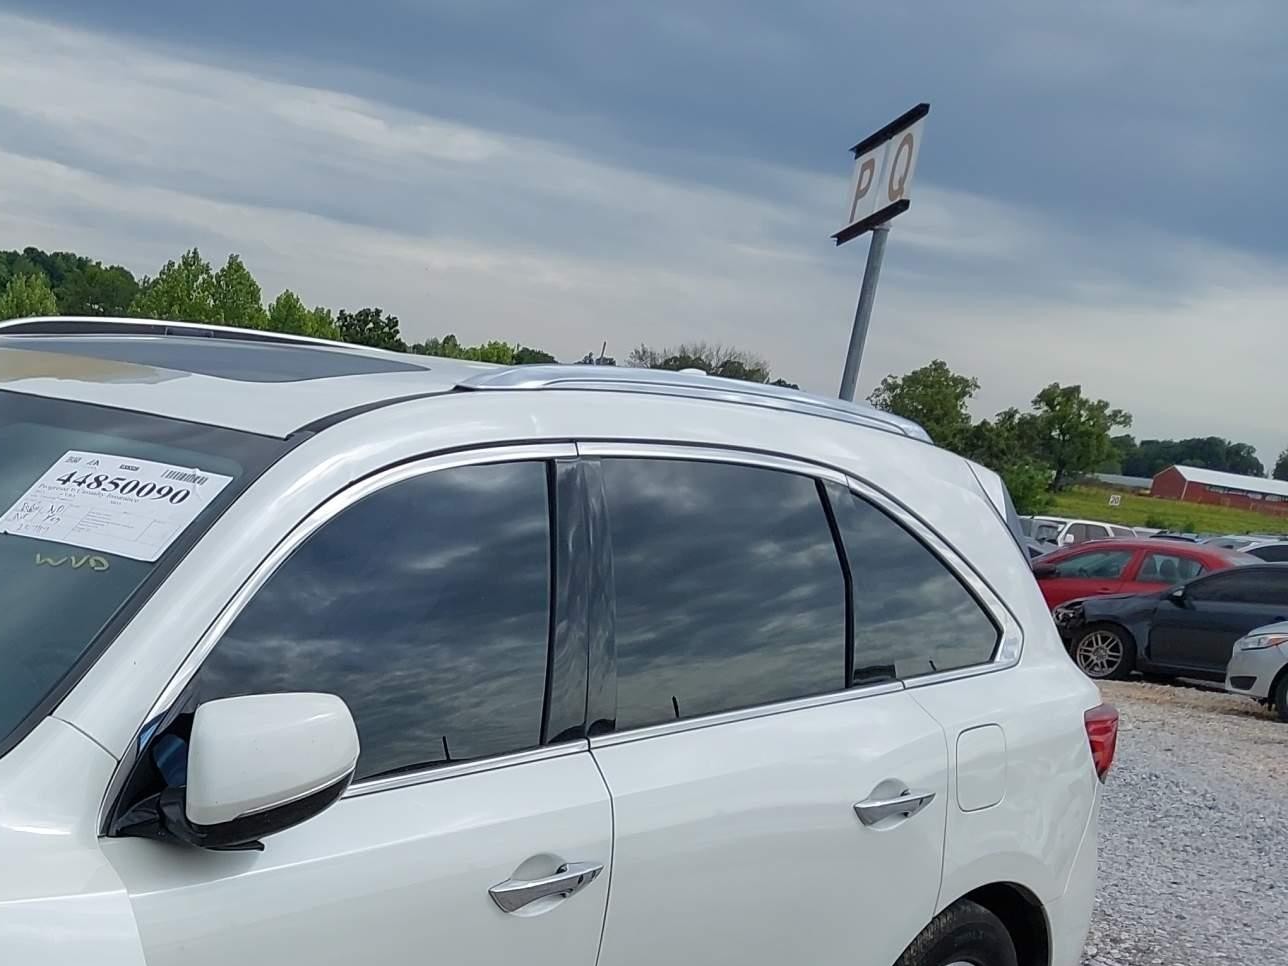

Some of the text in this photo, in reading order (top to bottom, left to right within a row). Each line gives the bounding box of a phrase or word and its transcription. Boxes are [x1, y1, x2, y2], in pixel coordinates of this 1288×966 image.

[849, 132, 914, 224] P Q
[55, 470, 191, 505] 44850090
